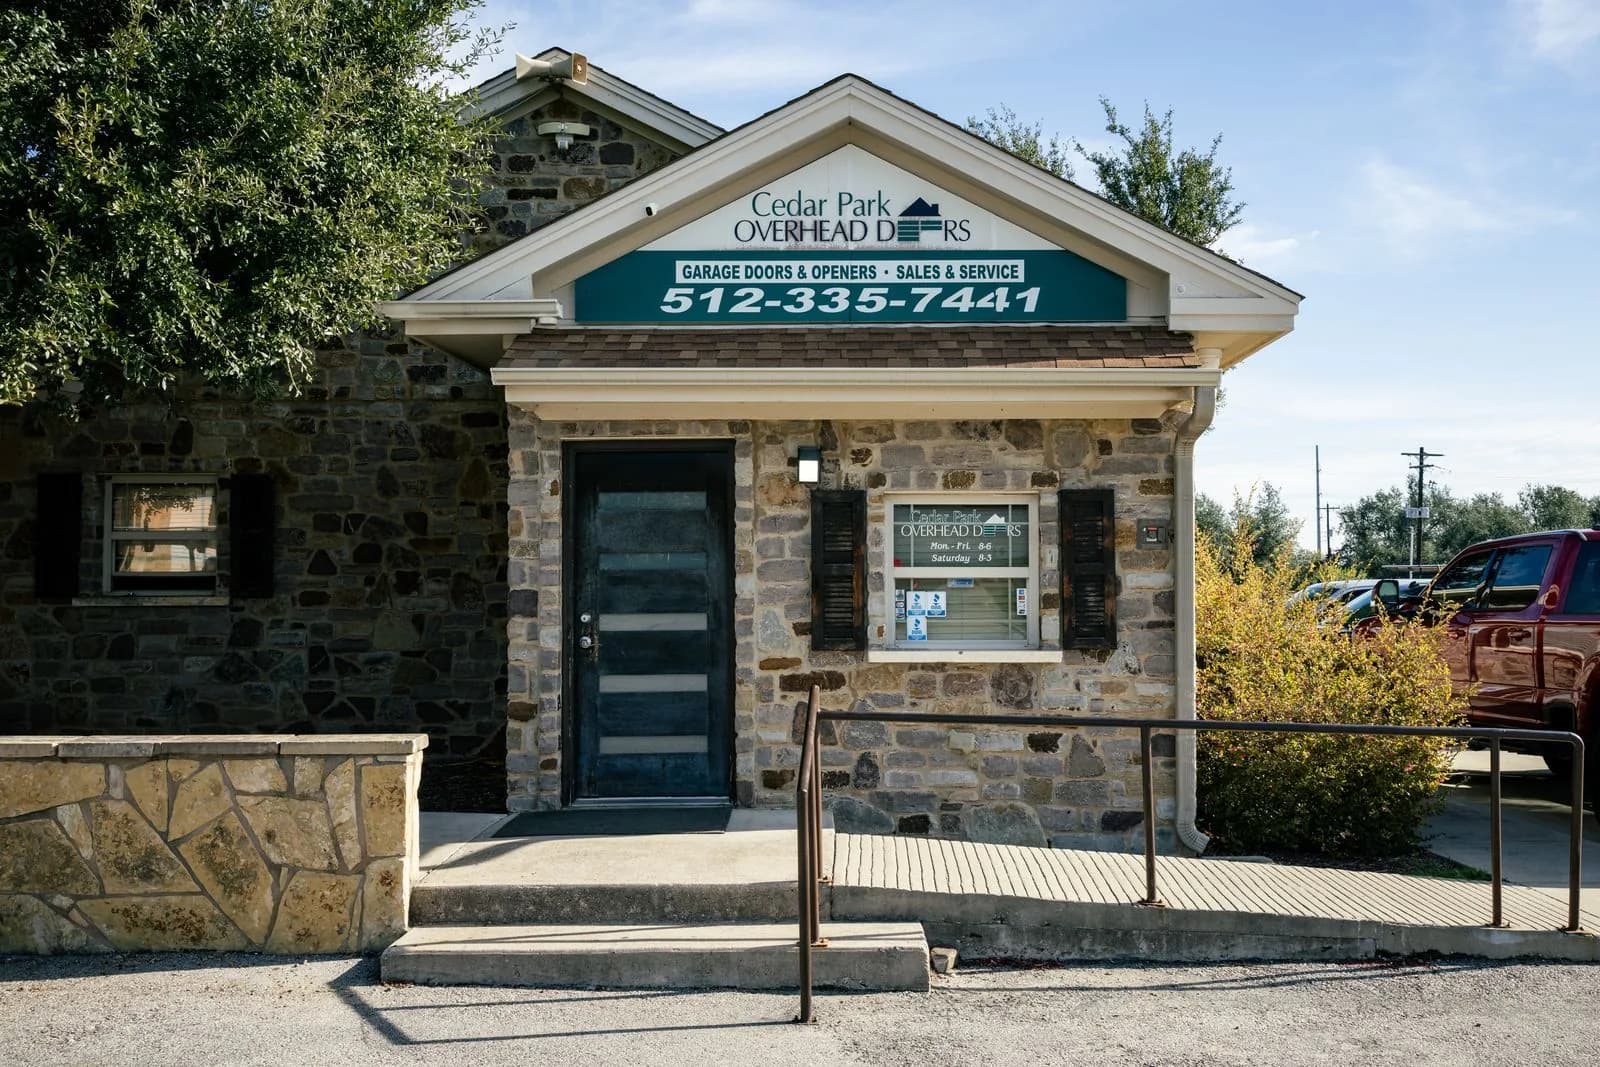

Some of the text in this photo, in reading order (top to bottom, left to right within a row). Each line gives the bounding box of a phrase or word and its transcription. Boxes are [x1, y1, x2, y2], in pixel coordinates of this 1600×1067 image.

[752, 190, 891, 217] Cedar Park
[734, 219, 868, 243] OVERHEAD
[682, 263, 1019, 280] GARAGE DOORS & OPENERS SALES & SERVICE
[660, 286, 1041, 314] 512-335-7441
[911, 509, 982, 524] Cedar Park
[901, 524, 969, 537] OVERHEAD
[931, 554, 971, 564] Saturday
